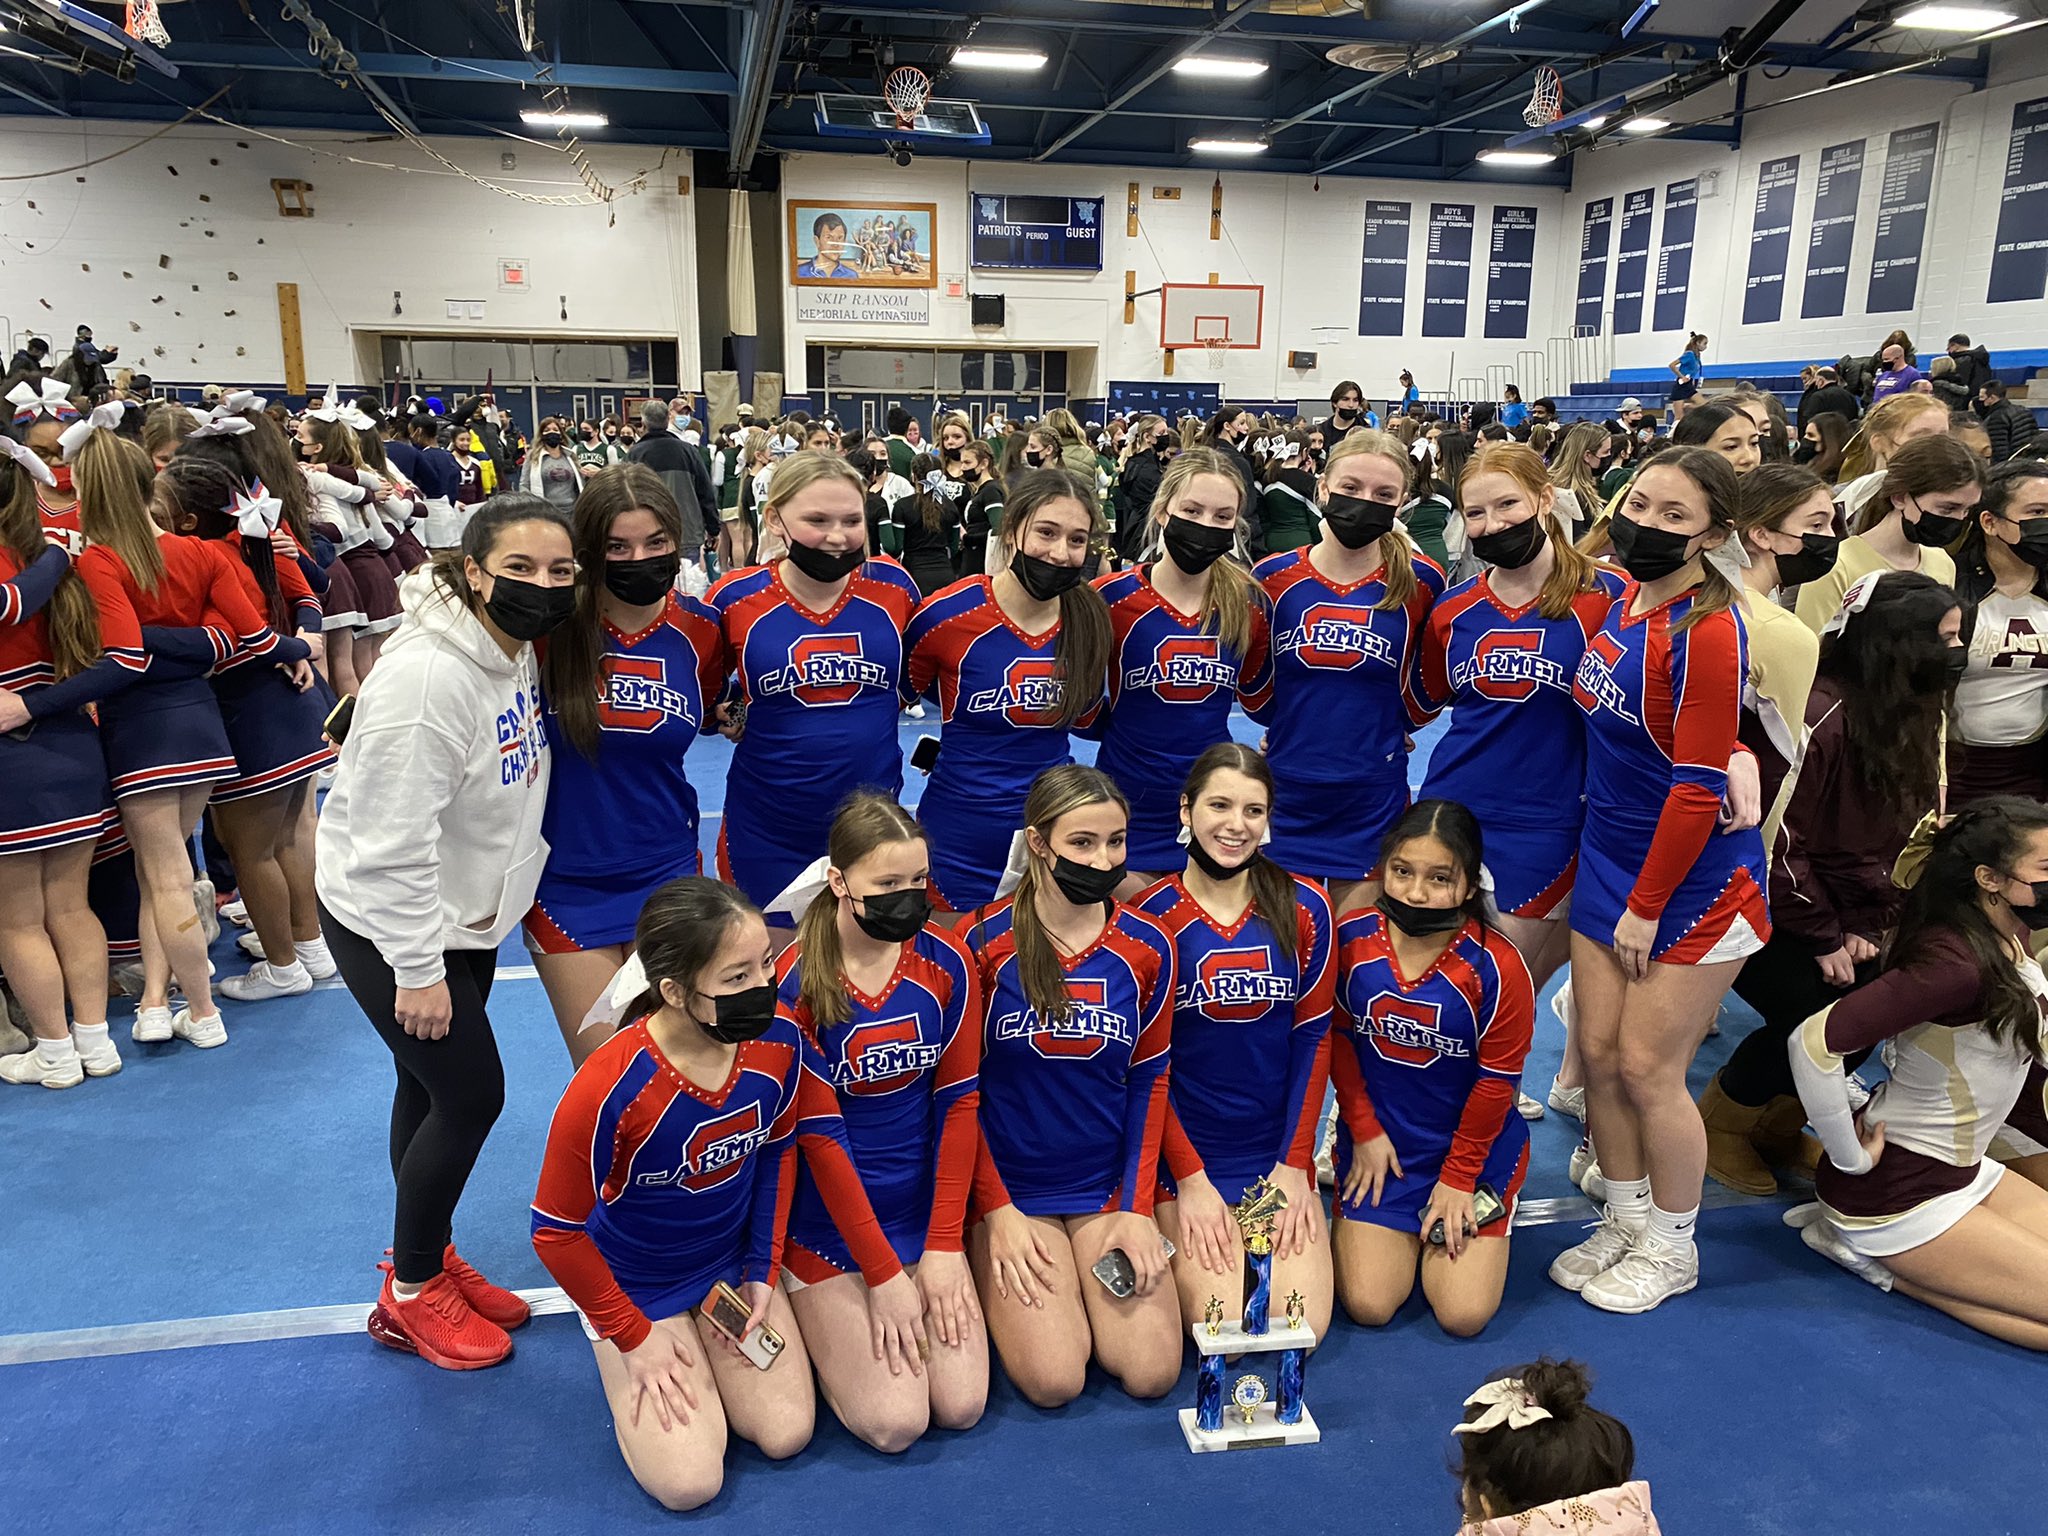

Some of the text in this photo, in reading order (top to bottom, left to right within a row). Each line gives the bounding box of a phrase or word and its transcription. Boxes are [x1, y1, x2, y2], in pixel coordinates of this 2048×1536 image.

[1444, 207, 1462, 216] BOYS
[1506, 210, 1525, 218] GIRLS
[978, 224, 1022, 236] PATRIOTS
[1026, 232, 1049, 240] PERIOD
[1066, 228, 1096, 238] GUEST
[816, 292, 909, 306] SKIP RANSOM
[800, 308, 927, 322] MEMORIAL GYMNASIUM
[459, 470, 475, 485] H
[1274, 619, 1397, 668] CARMEL
[758, 653, 889, 697] CARMEL
[1125, 655, 1237, 690] CARMEL
[1452, 648, 1572, 695] CARMEL
